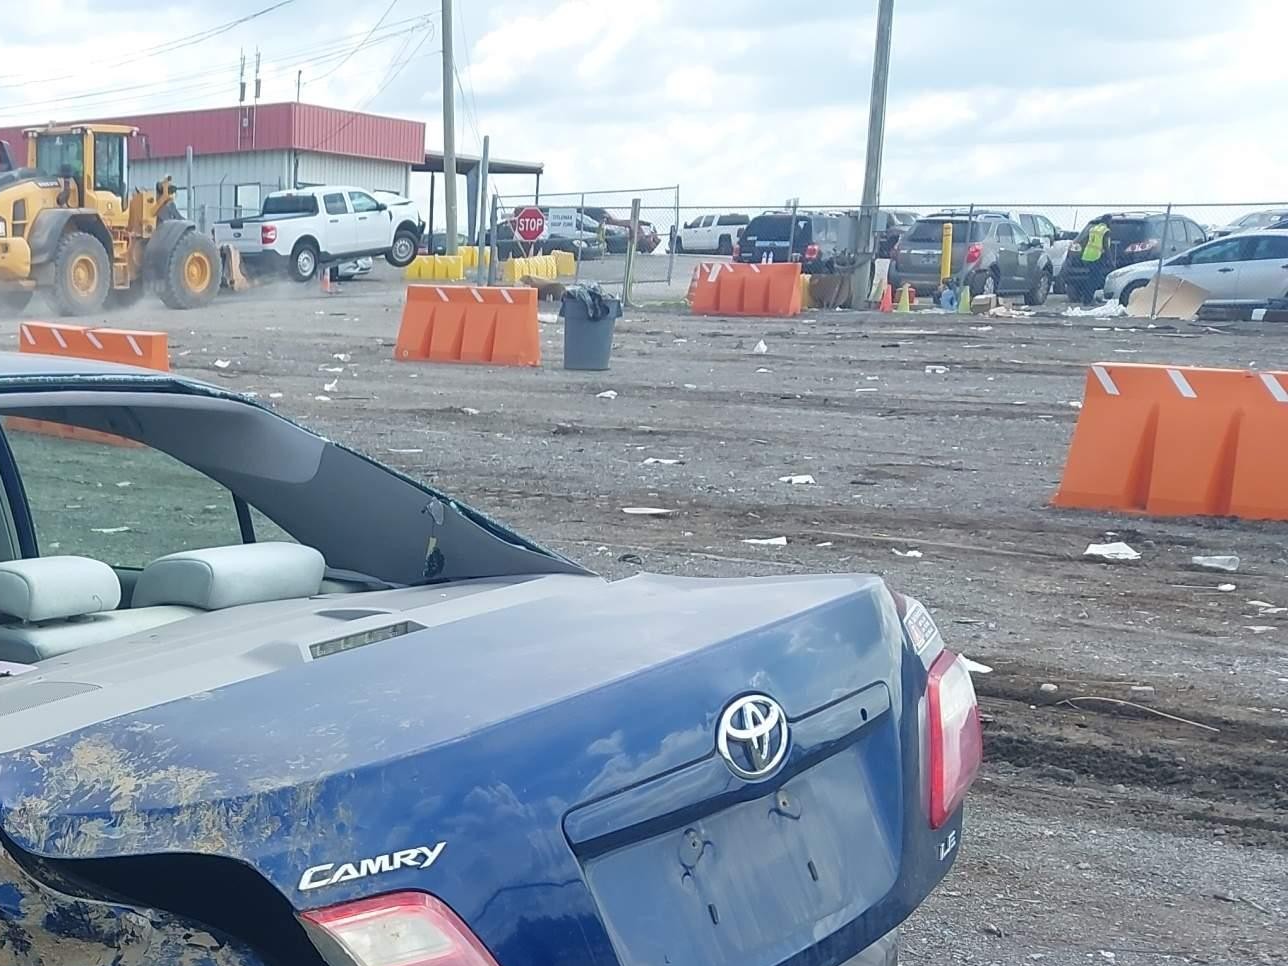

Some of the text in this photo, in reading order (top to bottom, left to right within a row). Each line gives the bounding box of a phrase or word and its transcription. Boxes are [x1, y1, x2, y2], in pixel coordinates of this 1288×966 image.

[518, 217, 543, 231] STOP
[939, 830, 957, 861] LE
[298, 842, 447, 891] CAMRY
